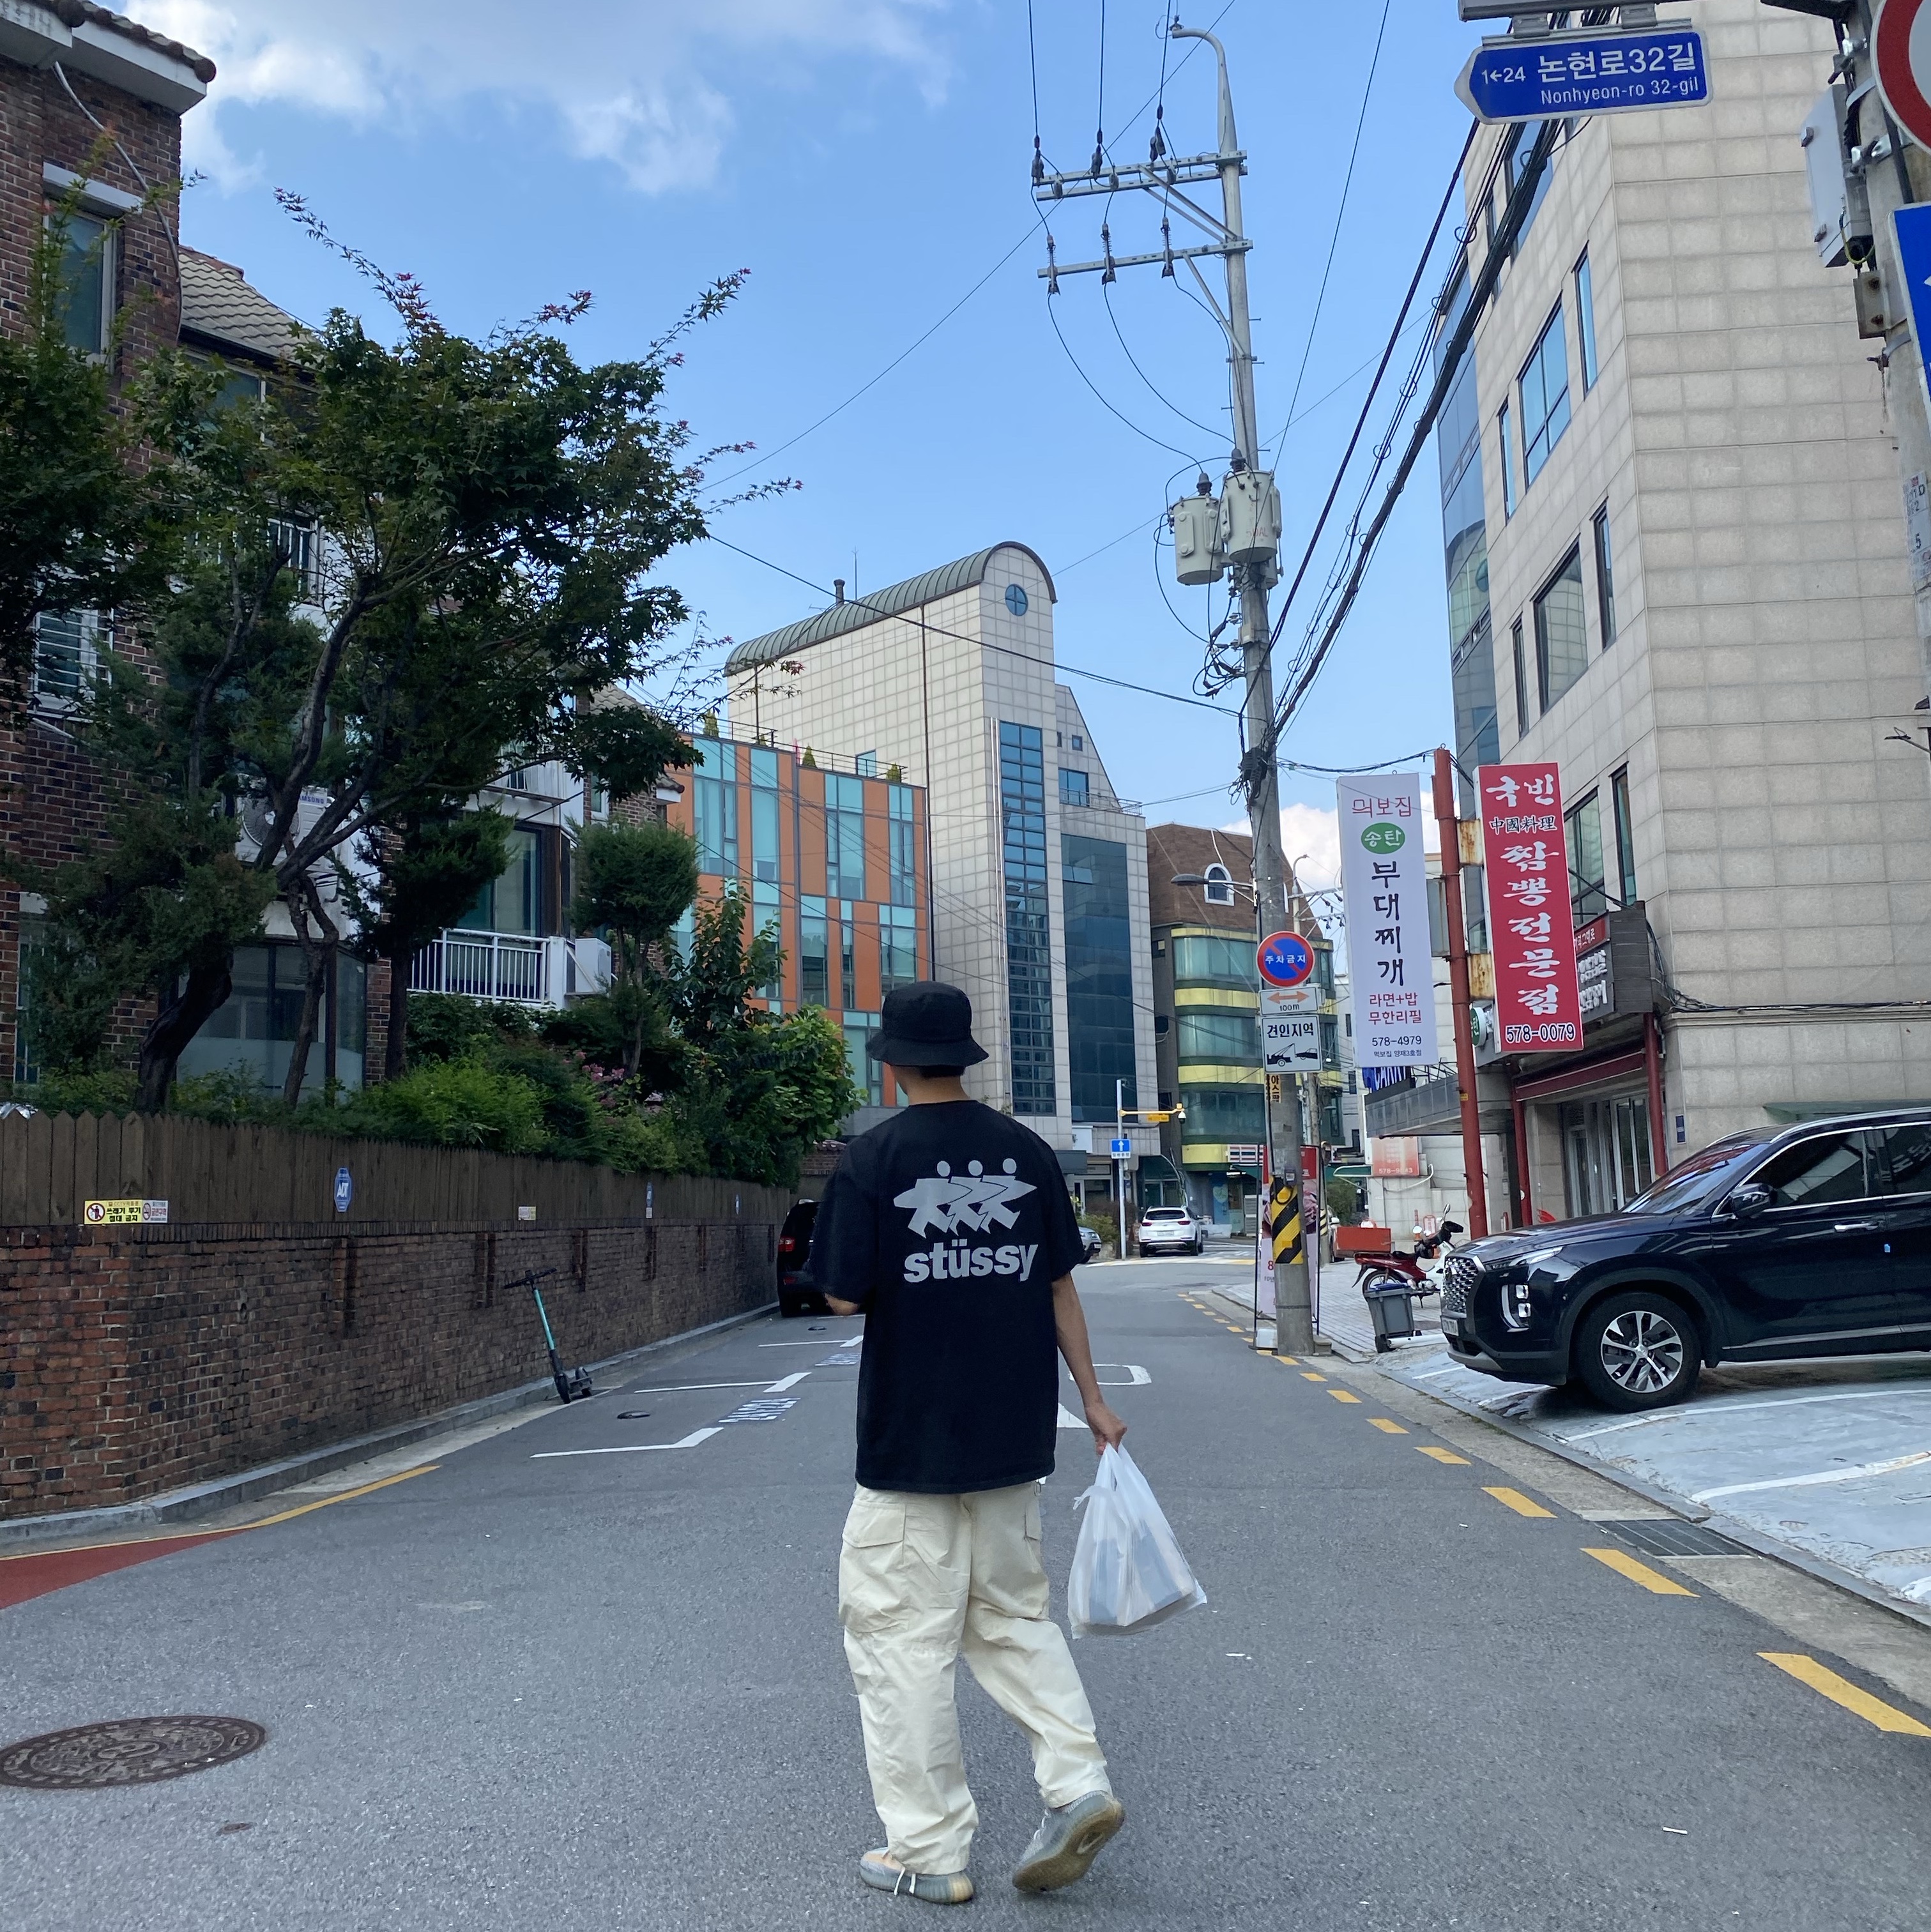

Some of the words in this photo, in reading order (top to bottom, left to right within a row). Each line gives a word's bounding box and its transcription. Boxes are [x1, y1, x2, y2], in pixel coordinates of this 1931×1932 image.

[1537, 42, 1696, 83] 논현로32길
[1541, 82, 1645, 105] Nonhyeon-ro
[1651, 76, 1699, 96] 32-gil
[1486, 773, 1554, 807] 국빈
[1490, 815, 1557, 835] 中國料理
[1364, 829, 1402, 848] 송탄
[1371, 861, 1404, 986] 부대찌개
[1500, 840, 1561, 1015] 짬뽕전문점
[1265, 954, 1306, 964] 주차금지
[1369, 993, 1418, 1008] 라면+밥
[1368, 1010, 1422, 1025] 무한리필
[1267, 1023, 1314, 1038] 견인지역
[1371, 1035, 1422, 1047] 578-4979
[1506, 1022, 1576, 1044] 578-0079
[903, 1238, 1039, 1283] stüssy
